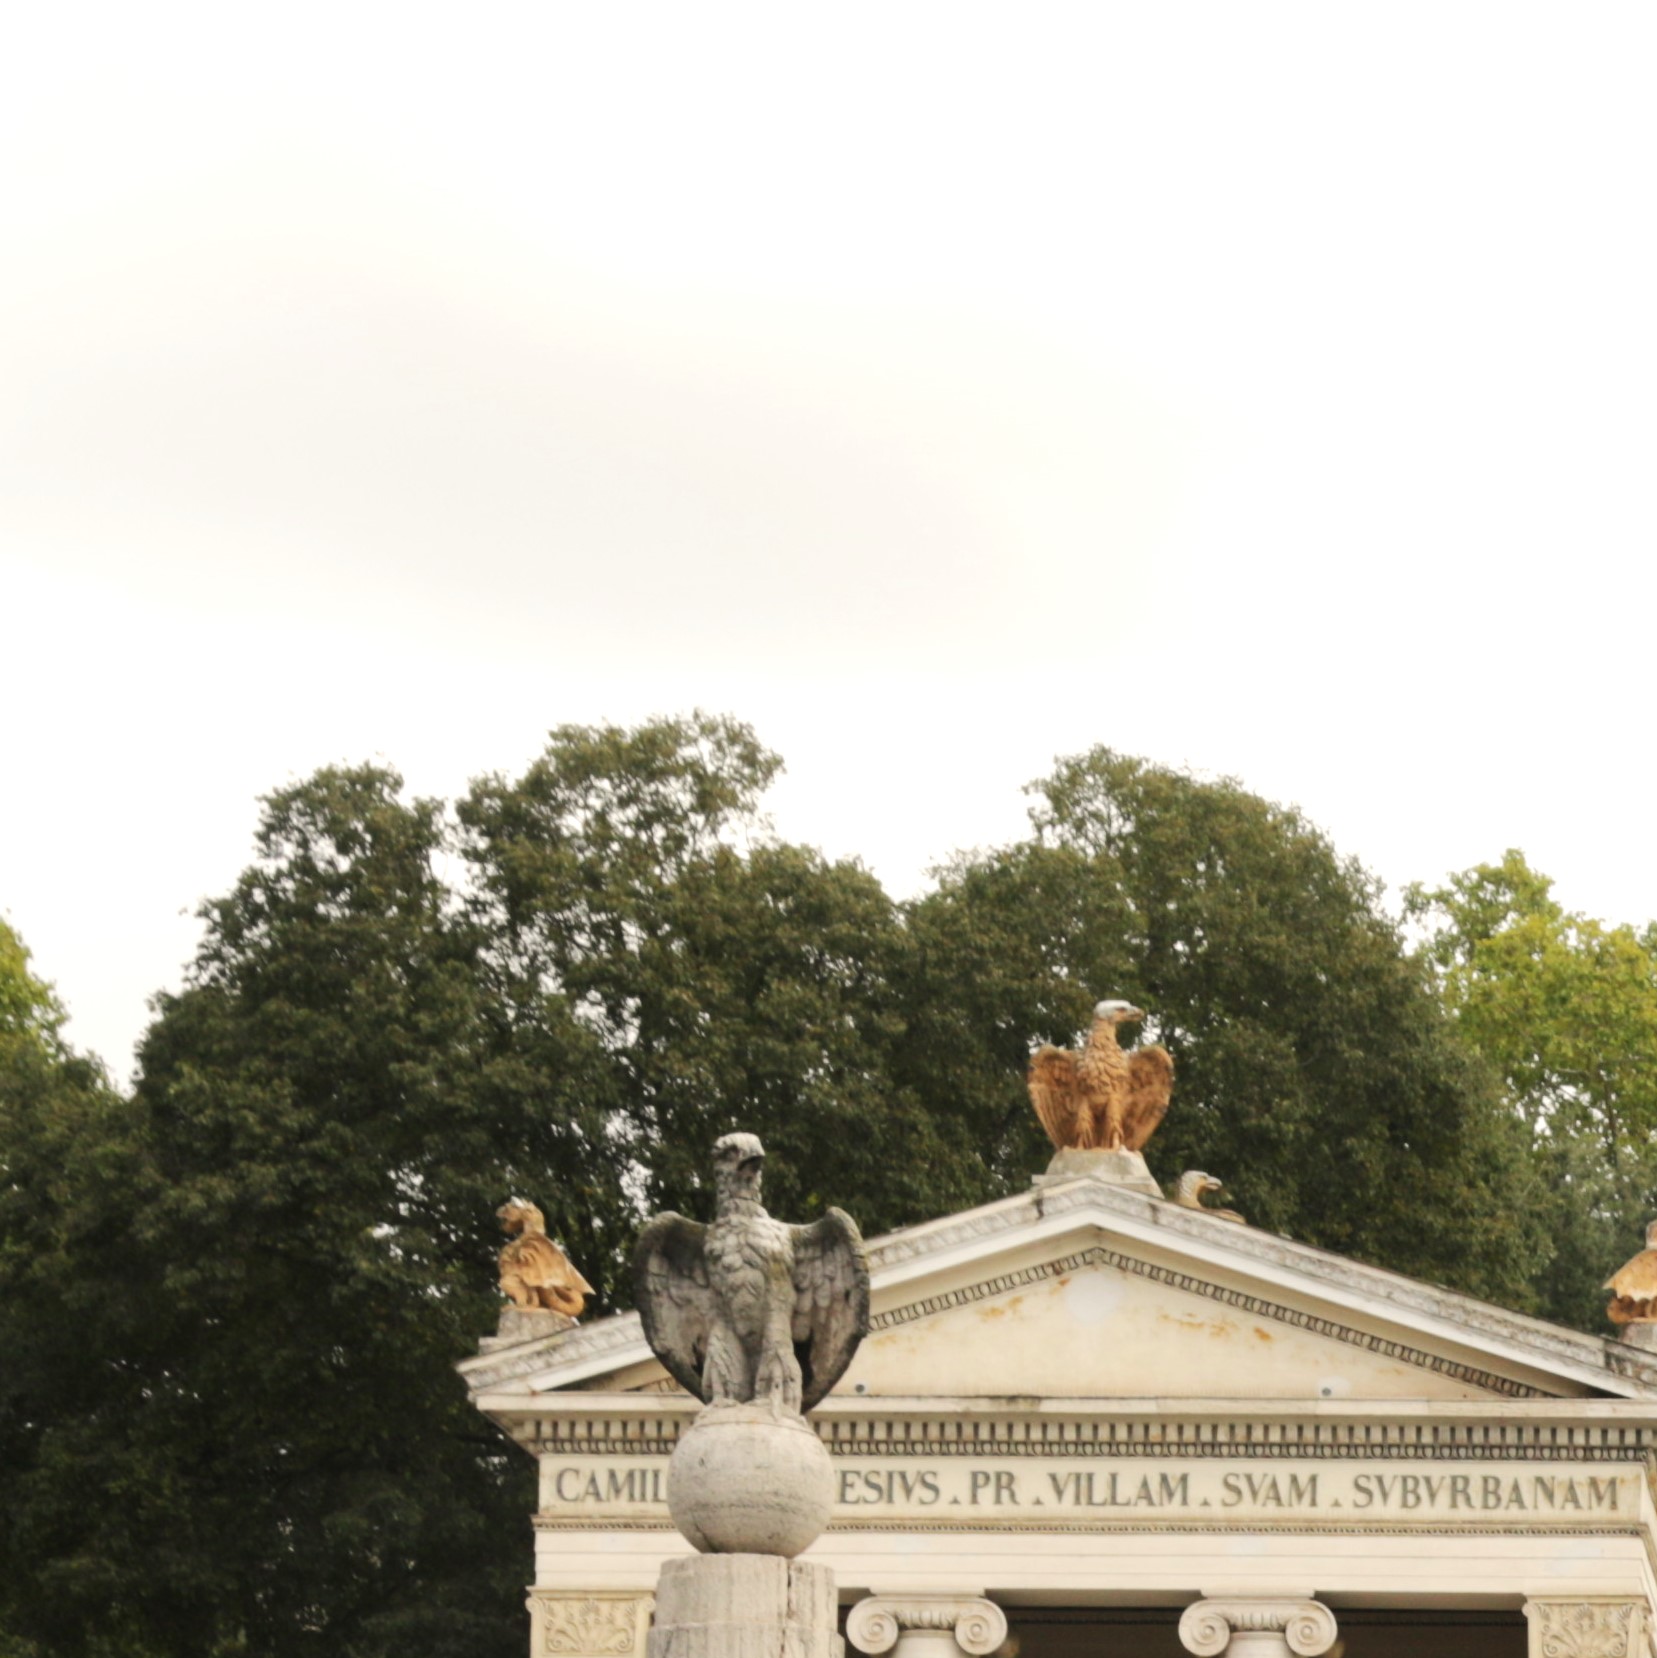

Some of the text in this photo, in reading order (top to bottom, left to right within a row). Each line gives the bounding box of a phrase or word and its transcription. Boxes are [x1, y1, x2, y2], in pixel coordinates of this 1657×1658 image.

[556, 1467, 1619, 1510] CAMIL ESIVS PR VILLAM SVAM SVBVRBANAM
